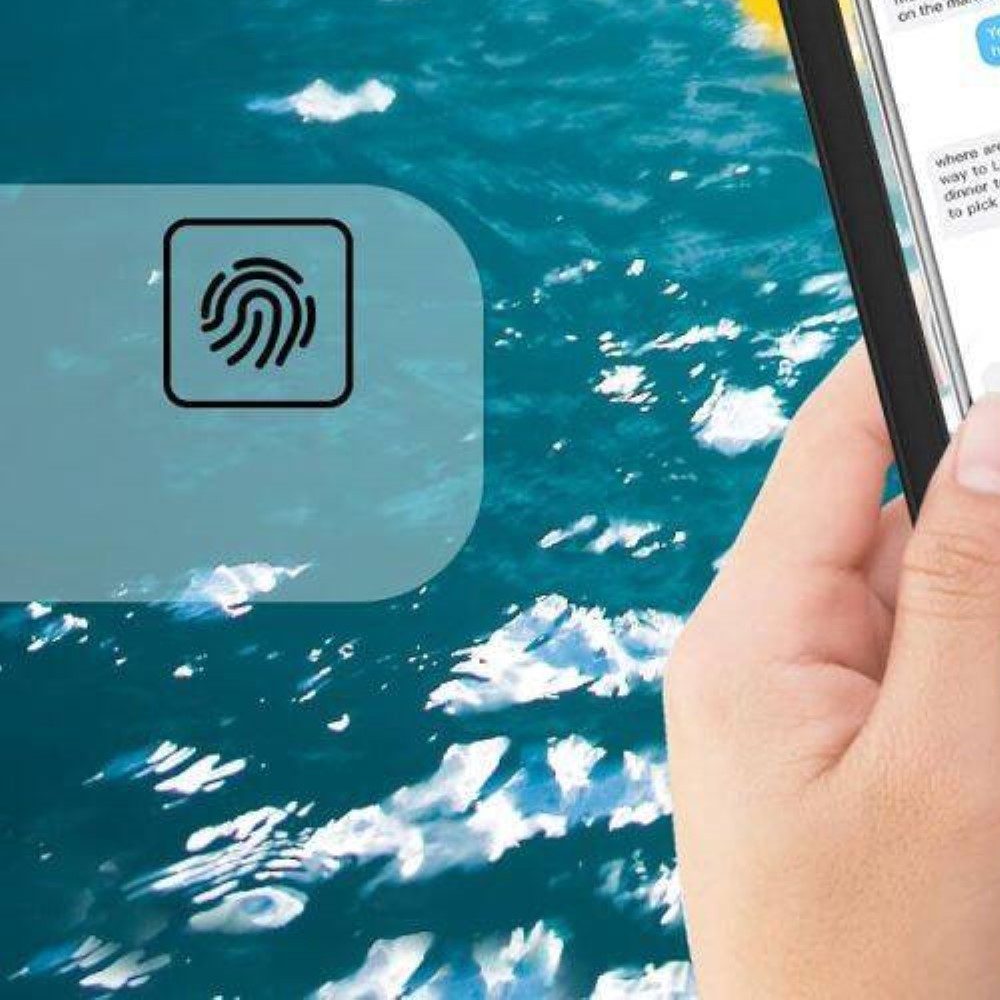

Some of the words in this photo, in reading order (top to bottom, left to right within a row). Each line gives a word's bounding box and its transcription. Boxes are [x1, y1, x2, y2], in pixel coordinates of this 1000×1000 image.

[898, 11, 916, 22] on
[919, 3, 943, 16] the
[935, 149, 979, 168] where
[939, 170, 968, 185] way
[972, 164, 987, 177] to
[944, 182, 987, 203] dinner
[948, 208, 962, 220] to
[967, 198, 998, 216] pick
